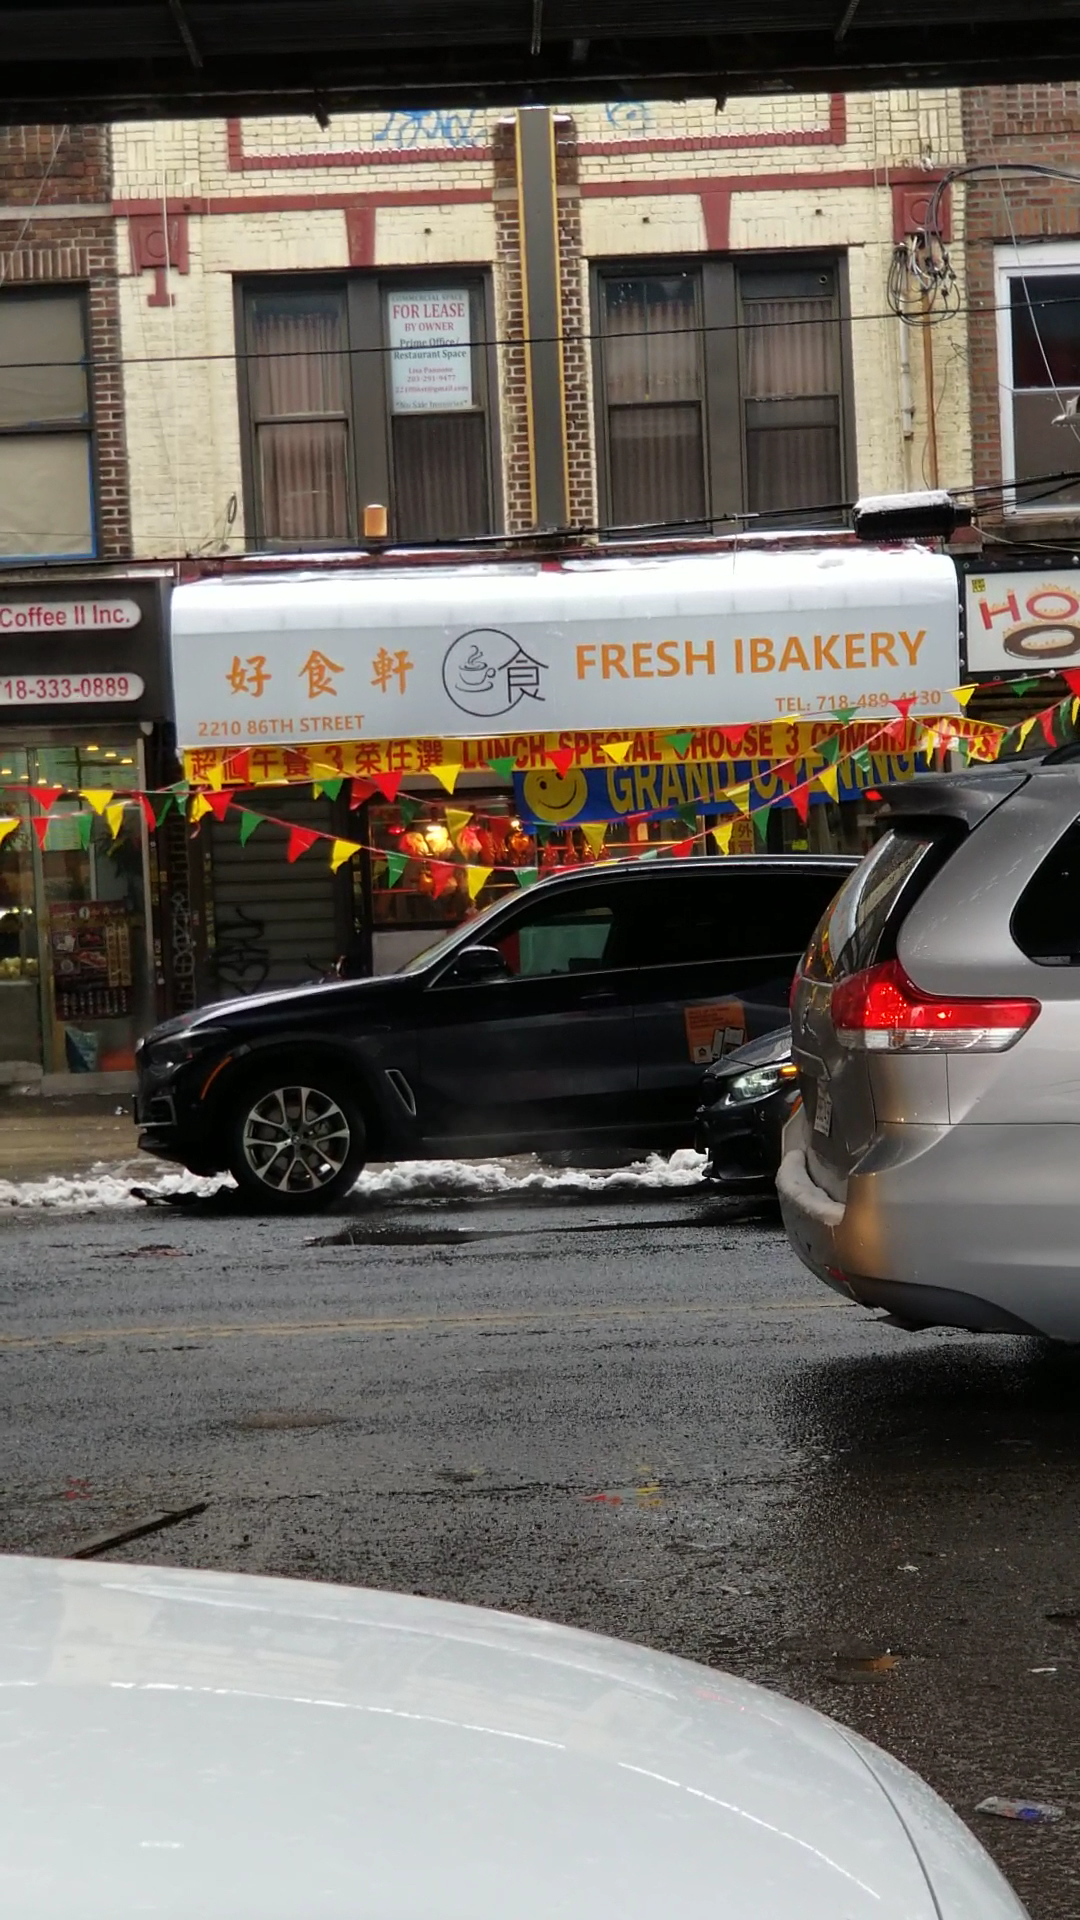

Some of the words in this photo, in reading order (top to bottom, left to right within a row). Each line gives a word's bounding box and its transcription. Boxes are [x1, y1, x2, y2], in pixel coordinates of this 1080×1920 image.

[393, 304, 420, 319] FOR
[424, 302, 466, 318] LEASE
[405, 323, 417, 332] BY
[419, 321, 454, 331] OWNER
[394, 350, 441, 360] Restaurant
[442, 349, 467, 360] Space
[400, 338, 427, 349] Prime
[0, 607, 67, 628] Coffee
[93, 604, 130, 624] Inc.
[575, 639, 717, 680] FRESH
[734, 629, 928, 675] IBAKERY
[225, 647, 415, 699] 好食軒
[0, 676, 129, 700] 18-333-0889
[775, 697, 811, 713] TEL:
[199, 720, 242, 737] 2210
[247, 719, 294, 736] 86TH
[299, 715, 366, 733] STREET
[462, 734, 547, 769] LUNCH
[786, 722, 799, 753] 3
